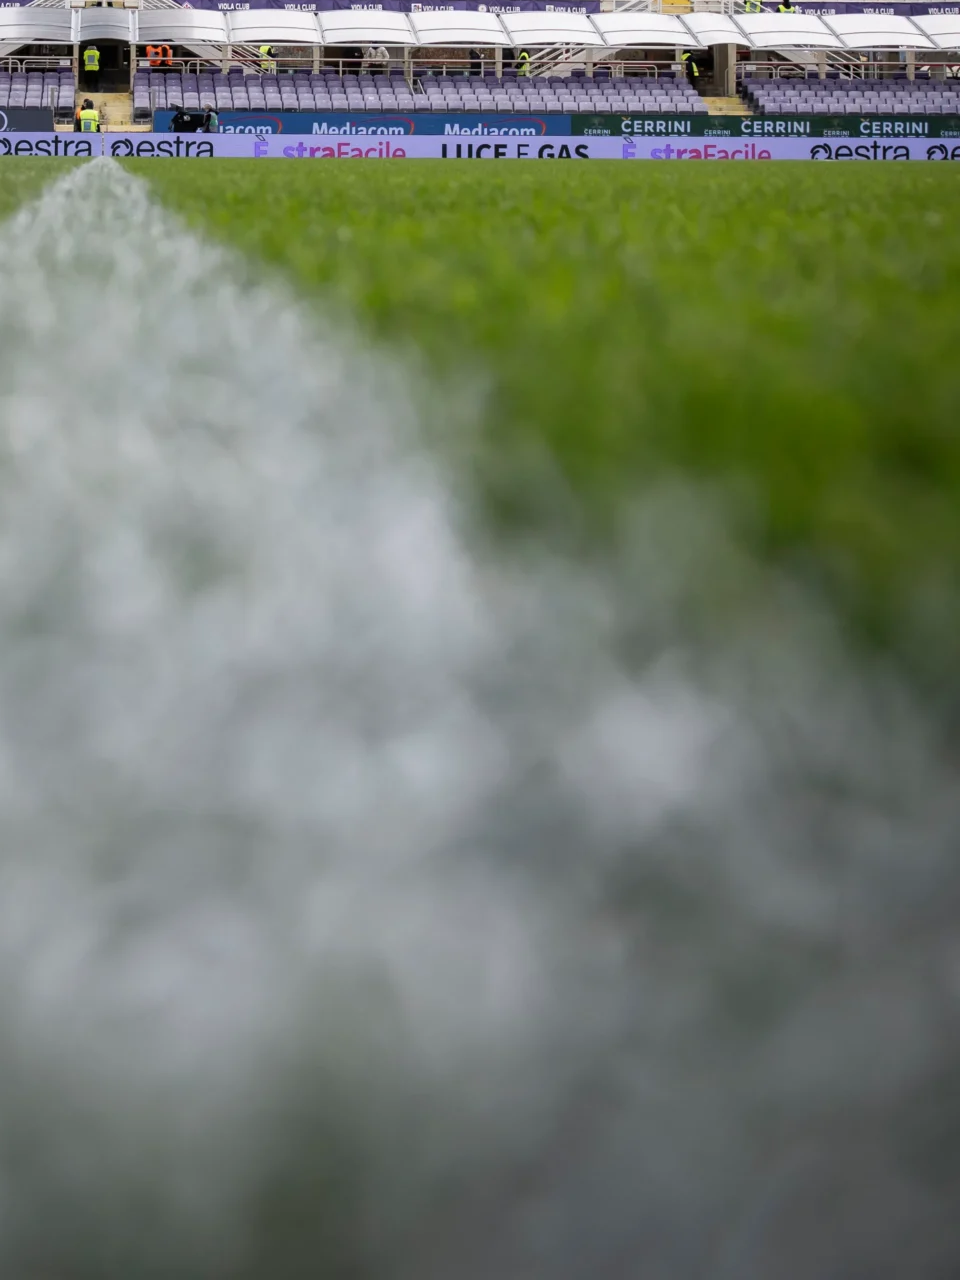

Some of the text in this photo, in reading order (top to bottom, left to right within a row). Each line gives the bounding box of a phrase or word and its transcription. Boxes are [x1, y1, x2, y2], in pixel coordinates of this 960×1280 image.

[284, 3, 300, 11] VIOLA
[805, 8, 820, 16] VIOLA
[312, 122, 404, 135] Mediacom
[444, 123, 536, 136] Mediacom
[538, 144, 590, 159] GAS
